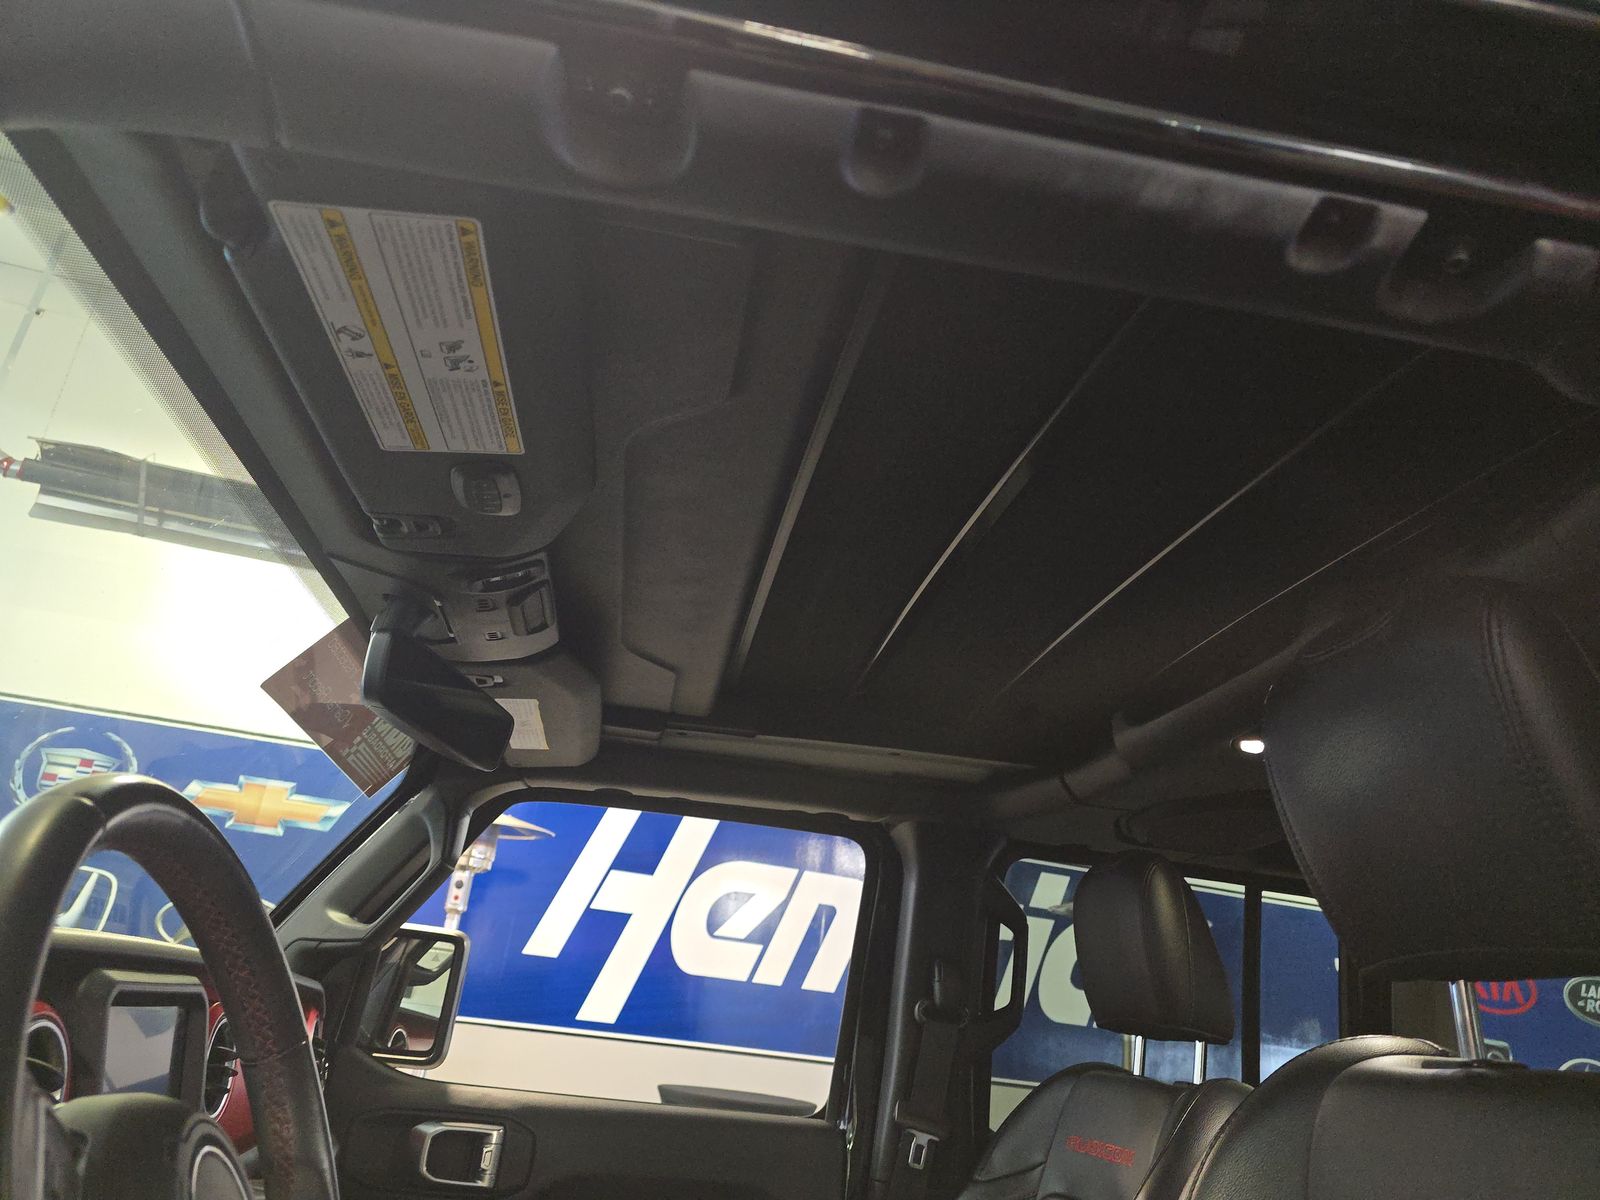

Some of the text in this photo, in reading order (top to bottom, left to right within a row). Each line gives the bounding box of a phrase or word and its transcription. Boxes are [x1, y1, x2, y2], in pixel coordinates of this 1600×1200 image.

[334, 233, 363, 281] WARNING
[464, 240, 484, 287] WARNING
[388, 374, 417, 424] MISE EN GARDE
